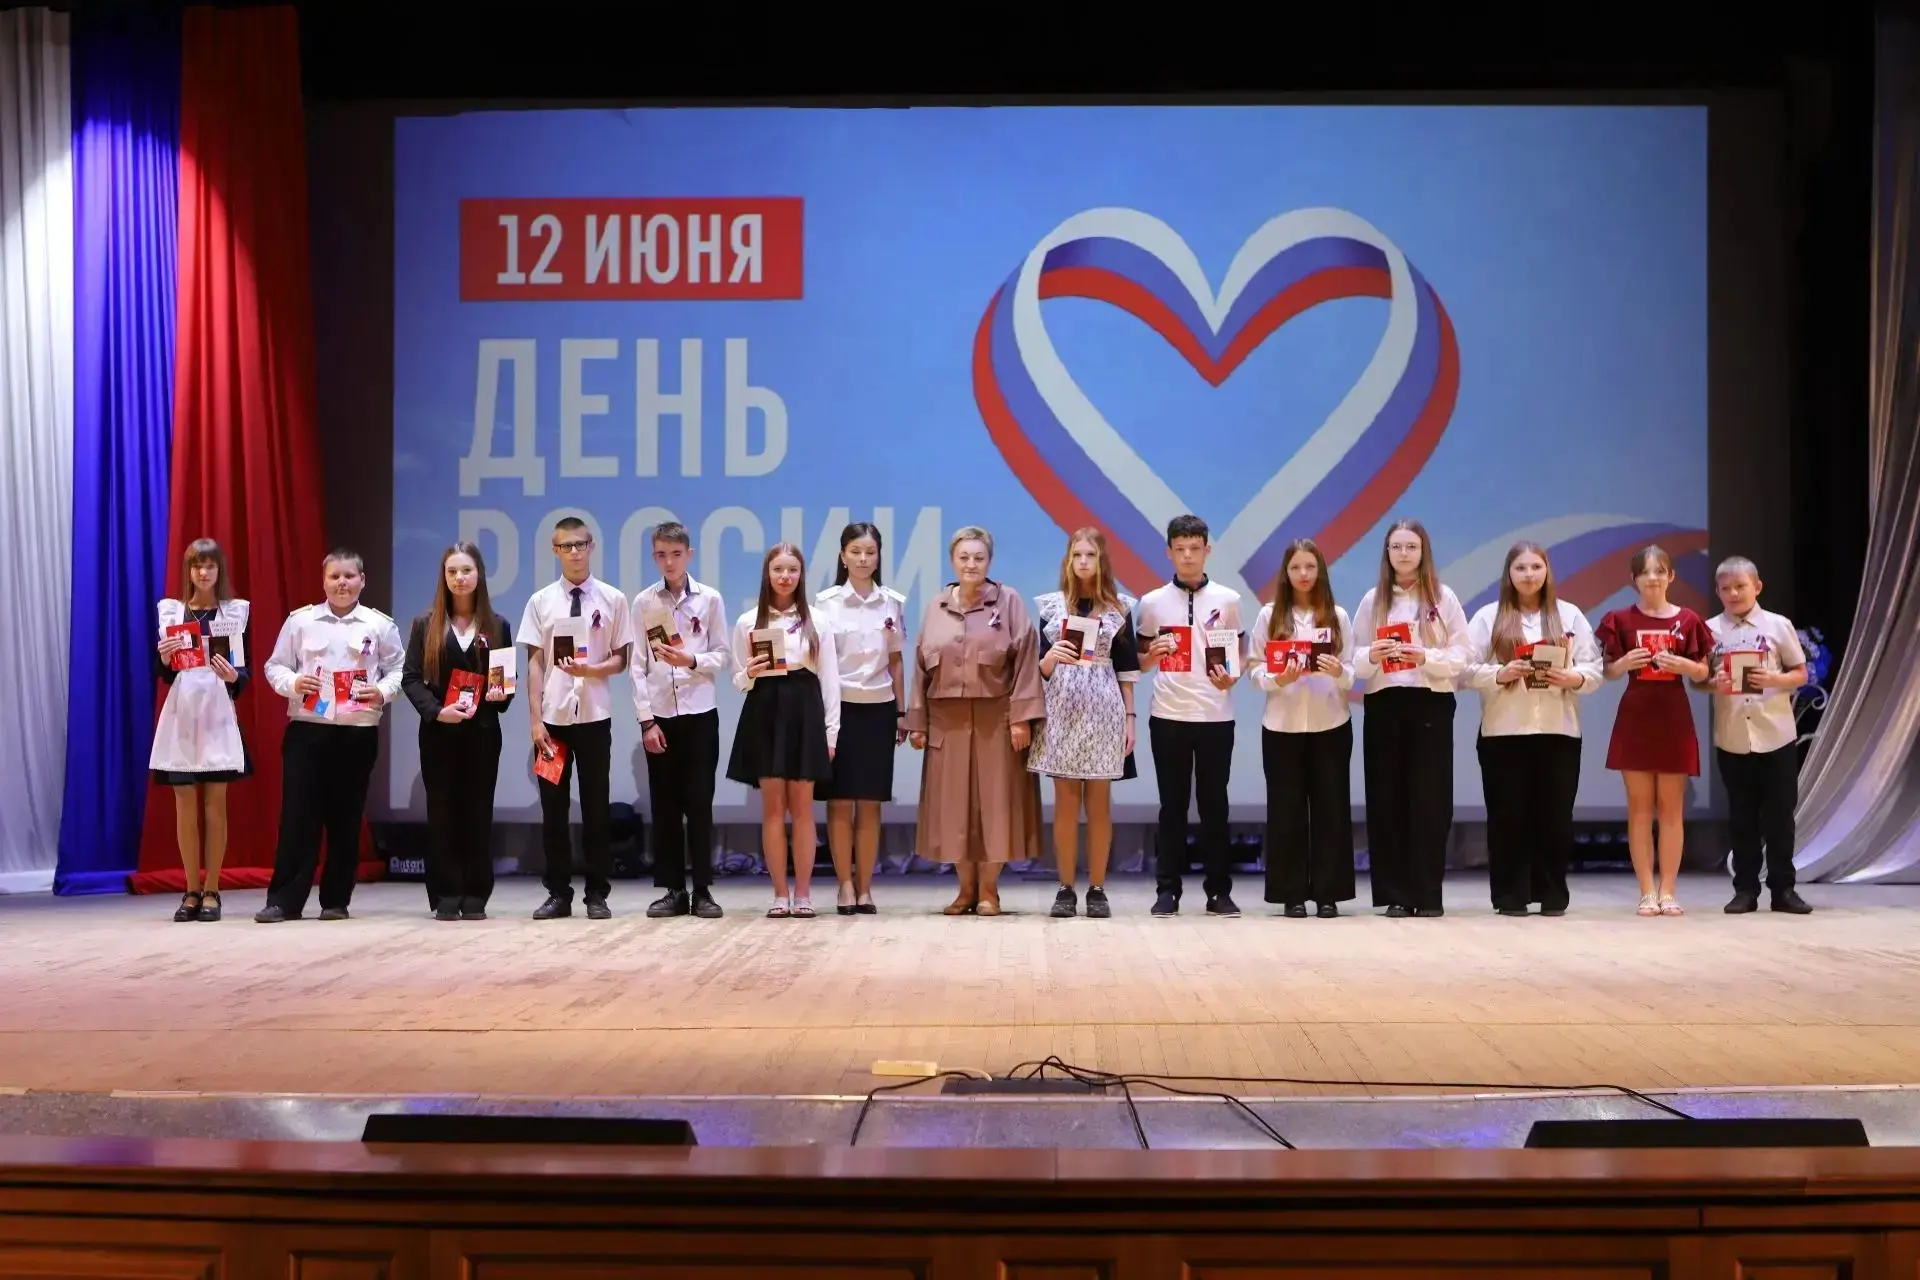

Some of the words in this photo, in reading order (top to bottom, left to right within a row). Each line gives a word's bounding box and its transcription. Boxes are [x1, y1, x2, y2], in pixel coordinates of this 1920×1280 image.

[496, 214, 563, 285] 12
[585, 213, 763, 284] ИЮНЯ
[458, 338, 788, 497] ДЕНЬ
